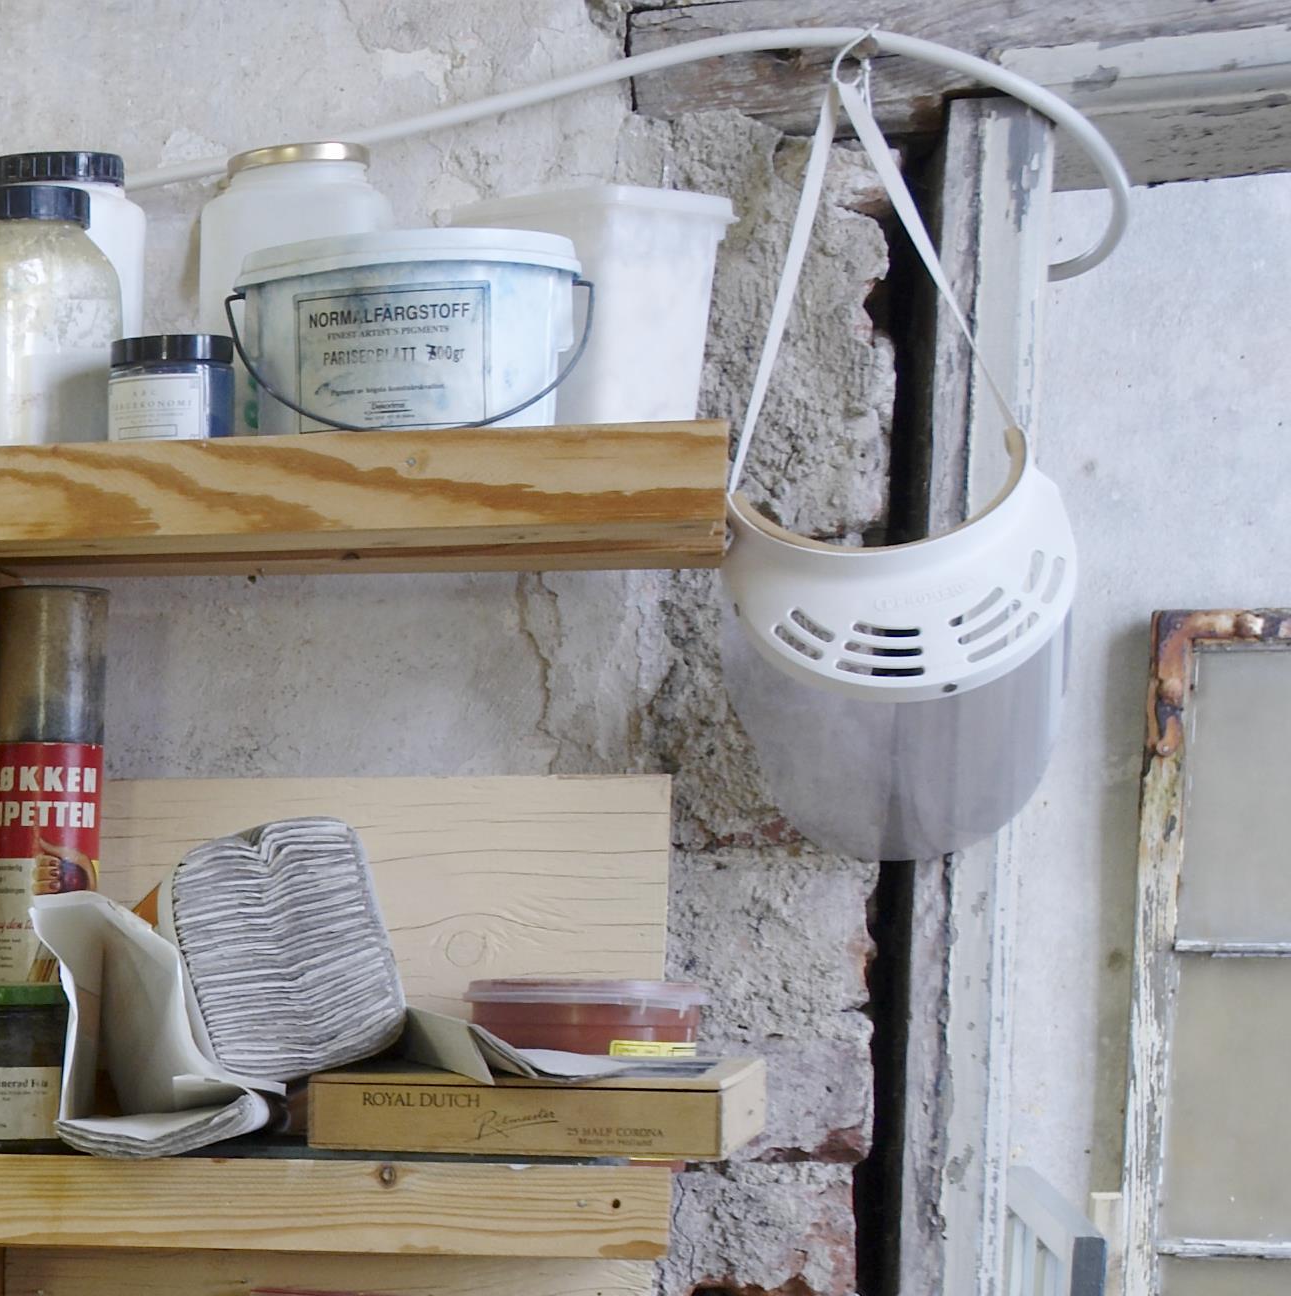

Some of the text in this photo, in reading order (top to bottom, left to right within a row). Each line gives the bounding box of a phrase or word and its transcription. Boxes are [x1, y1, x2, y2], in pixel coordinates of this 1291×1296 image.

[308, 301, 471, 329] NORMALFÄRGSTOFF
[327, 331, 357, 341] FINEST
[400, 325, 450, 335] PIGMENTS
[362, 1091, 481, 1109] ROYAL DUTCH
[566, 1128, 664, 1138] 25 HALF CORONA
